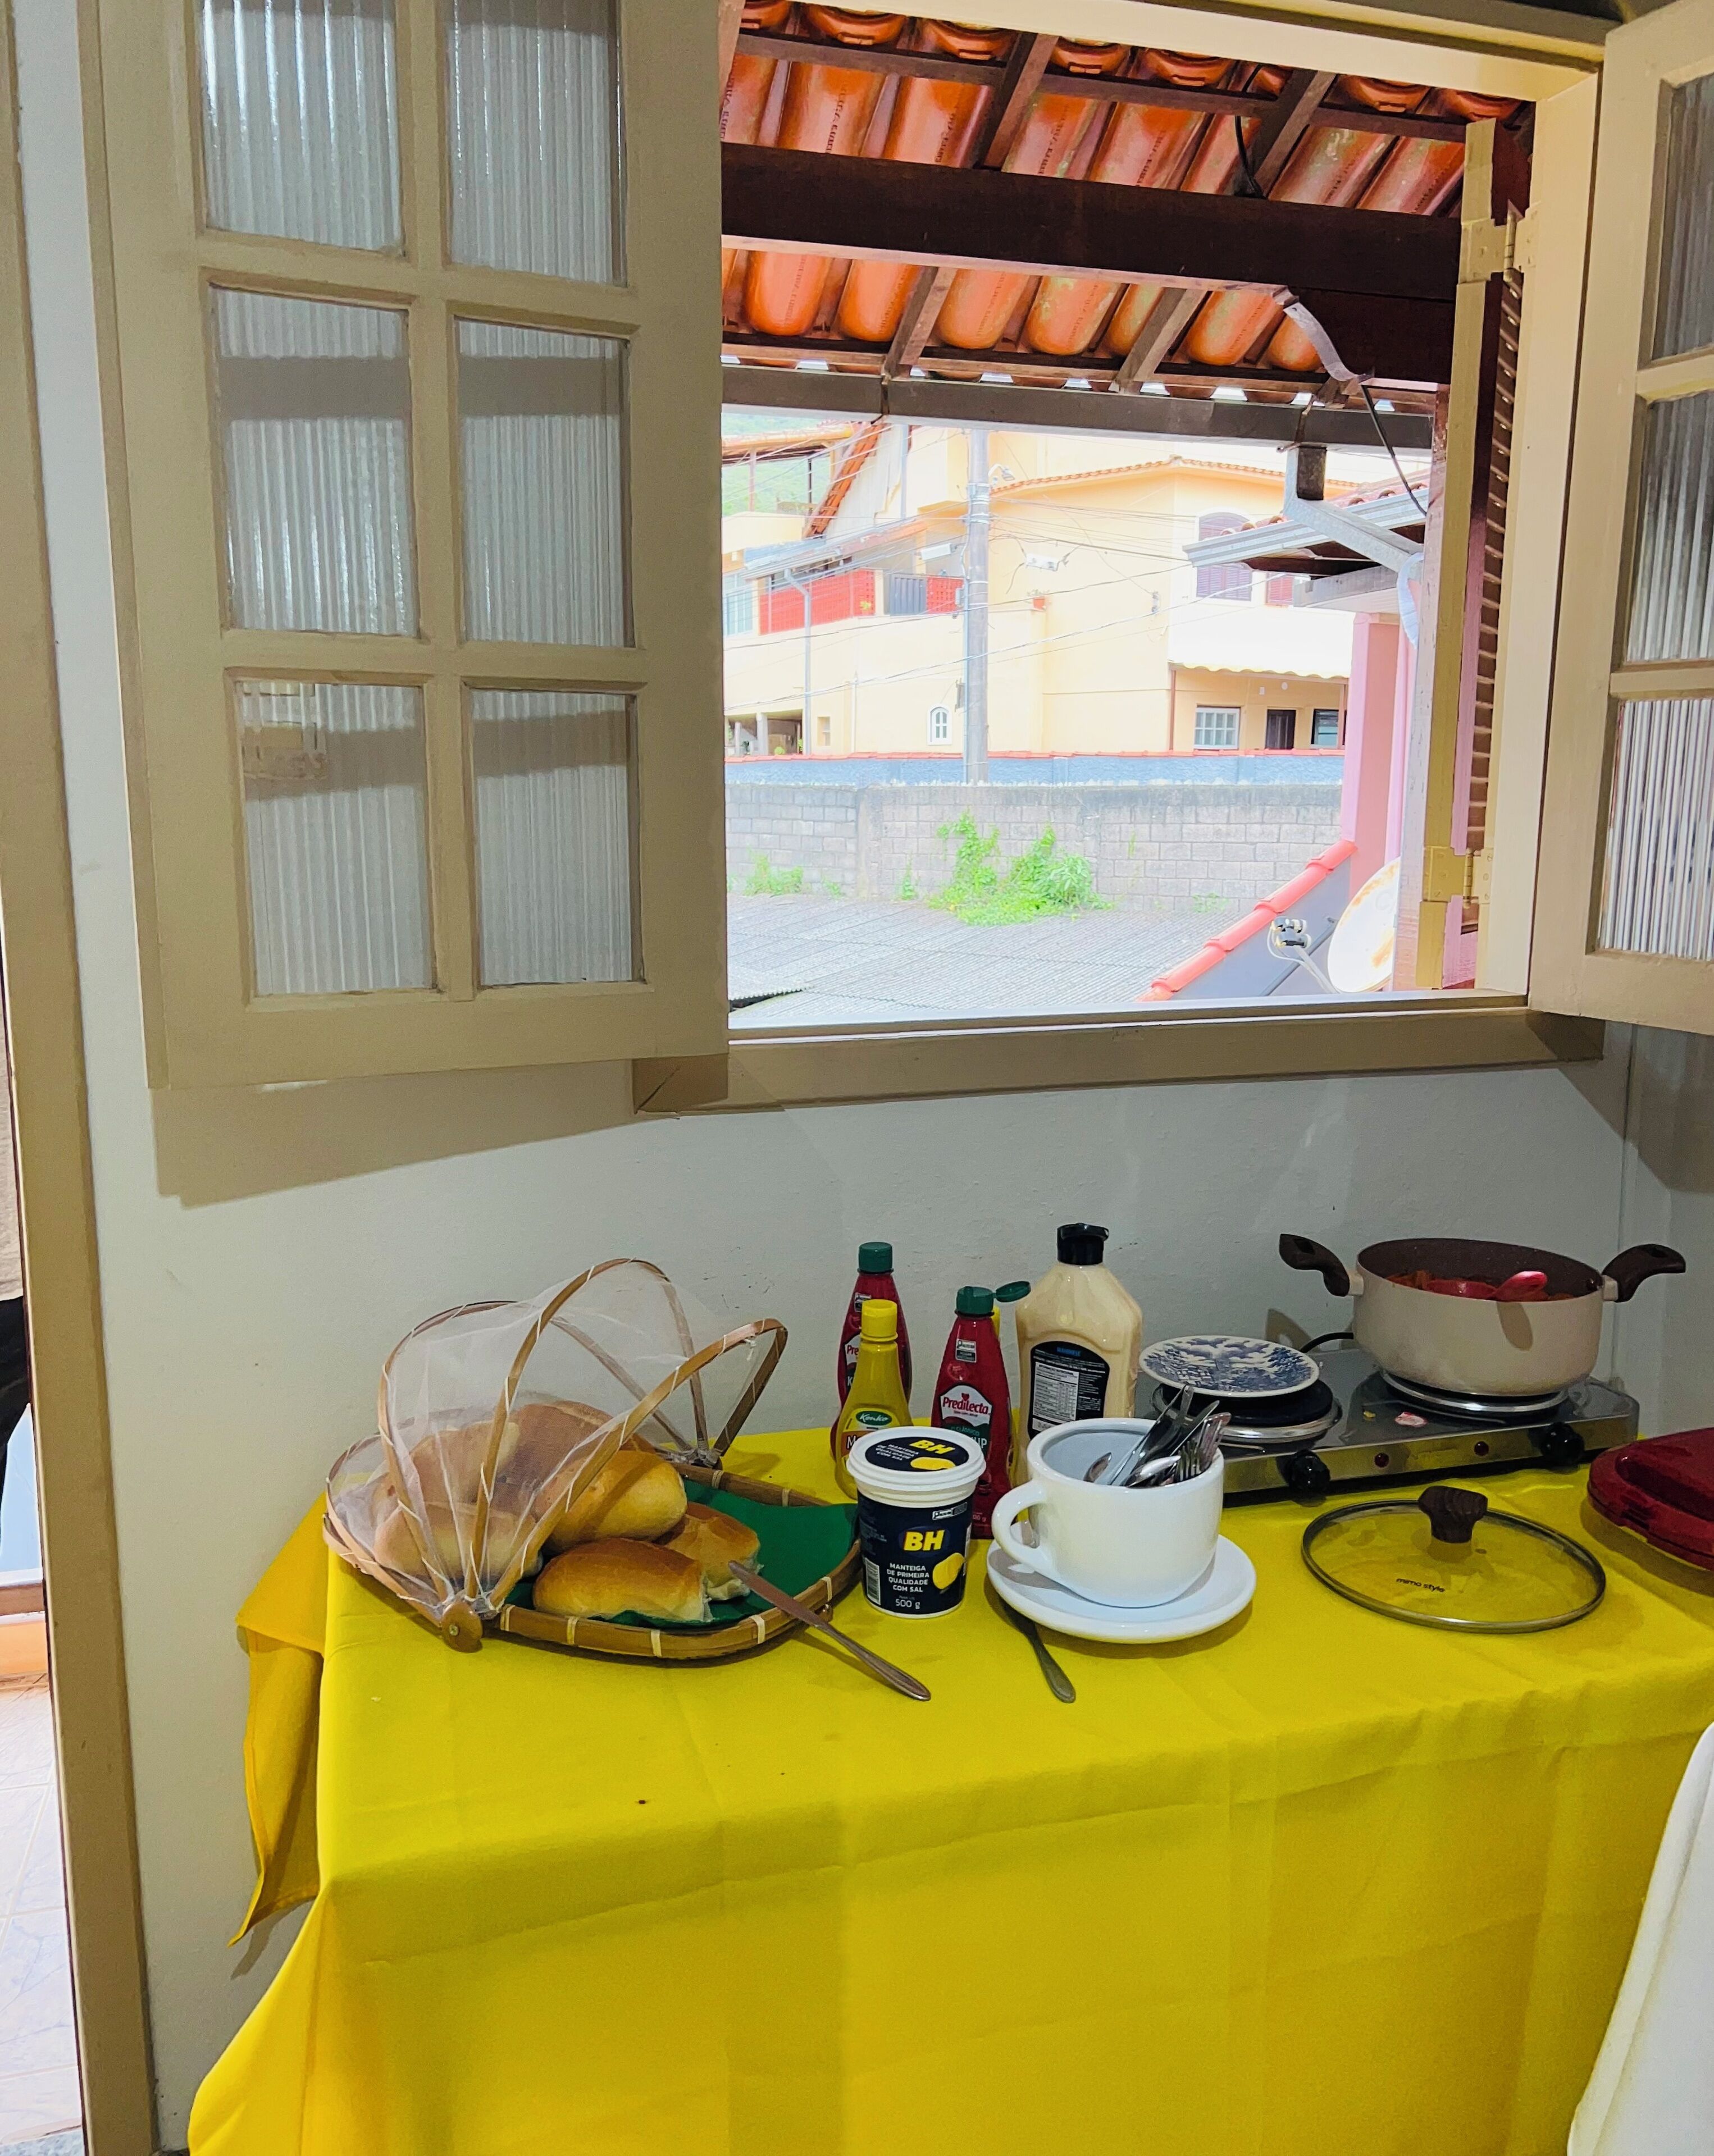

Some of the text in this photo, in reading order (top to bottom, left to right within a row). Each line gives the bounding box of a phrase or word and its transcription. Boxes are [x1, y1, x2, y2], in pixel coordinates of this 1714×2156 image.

[942, 1396, 989, 1415] Predilecta
[860, 1413, 889, 1423] Kenko
[909, 1440, 955, 1455] BH
[903, 1529, 945, 1551] BH
[890, 1563, 926, 1572] MANTEIGA
[888, 1577, 928, 1586] QUALIDADE
[1396, 1578, 1446, 1592] mimo style
[895, 1598, 912, 1607] 500
